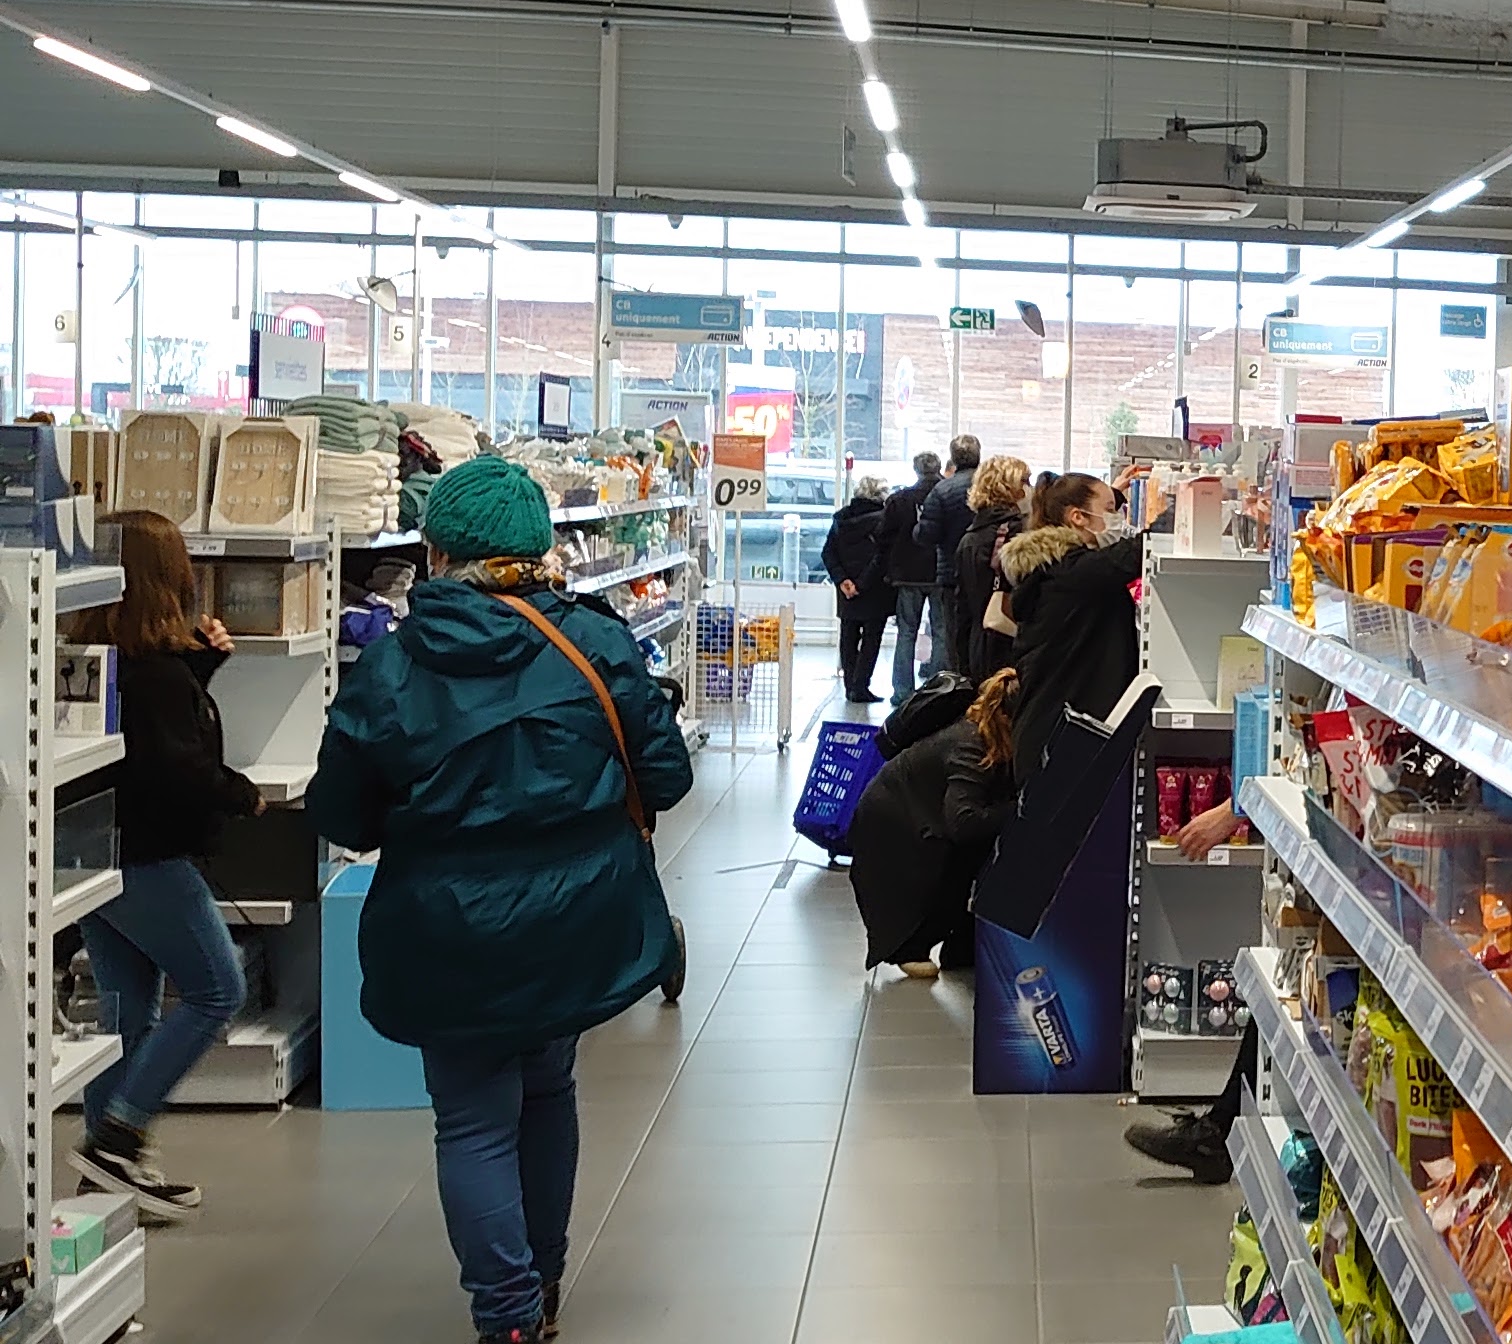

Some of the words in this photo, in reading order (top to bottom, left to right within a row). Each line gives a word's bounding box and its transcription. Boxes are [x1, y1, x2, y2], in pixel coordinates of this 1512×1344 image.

[615, 300, 631, 310] CB
[55, 315, 65, 331] 6
[615, 313, 680, 324] uniquement
[393, 325, 404, 342] 5
[707, 333, 740, 342] ACTION
[1272, 327, 1288, 338] CB
[602, 334, 611, 348] 4
[1272, 340, 1333, 351] uniquement
[1357, 359, 1387, 367] ACTION
[1249, 364, 1258, 379] 2
[648, 400, 688, 411] ACTION
[1035, 1007, 1060, 1055] VARTA
[1406, 1056, 1449, 1083] LUC
[1410, 1084, 1467, 1109] BITES
